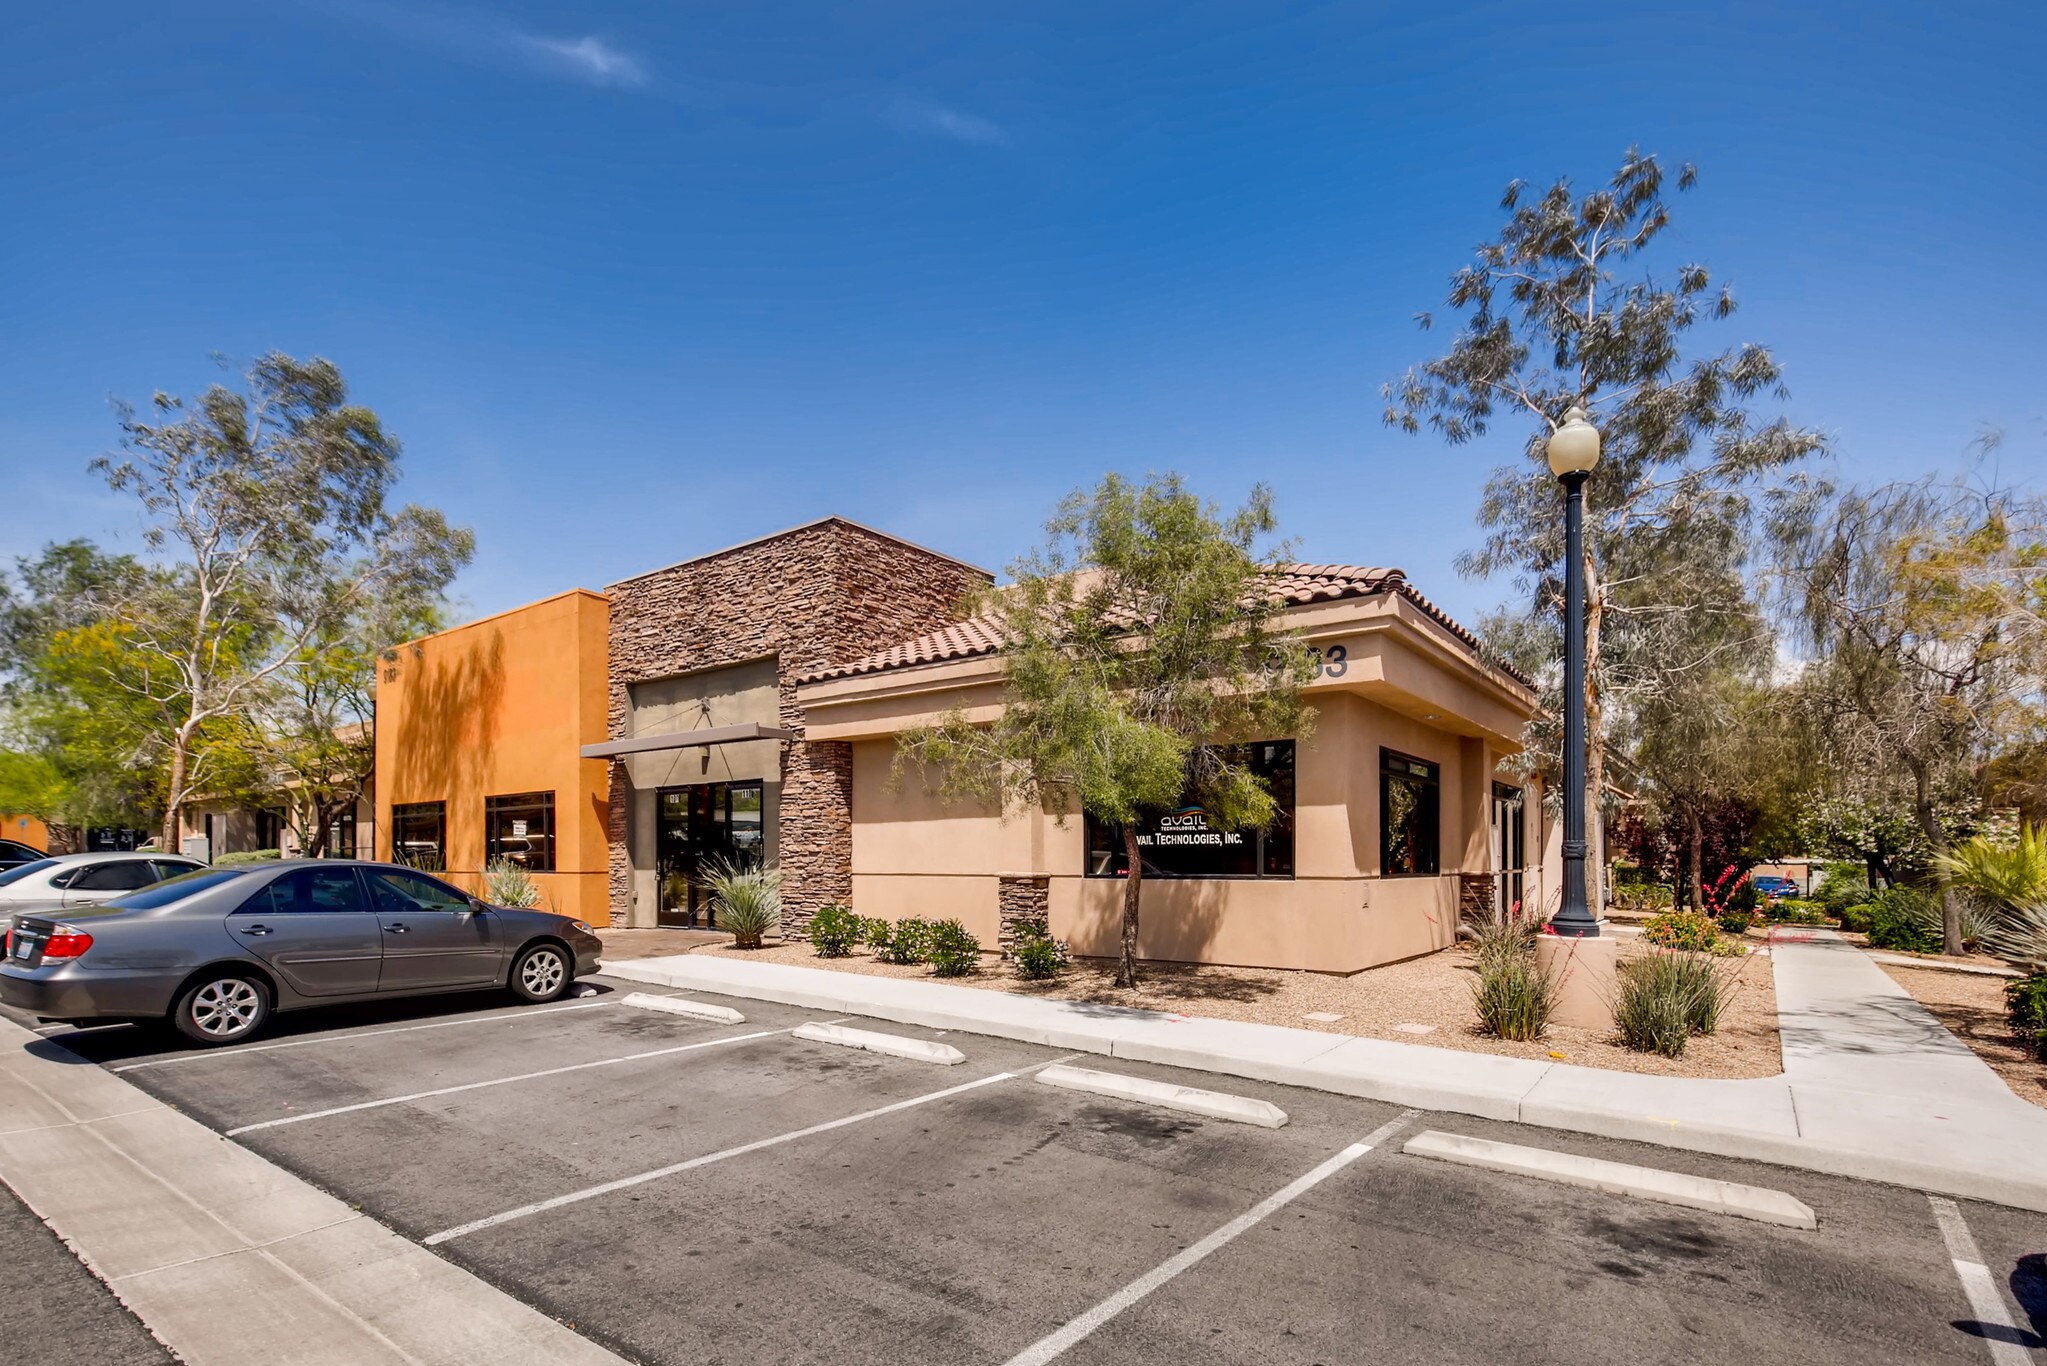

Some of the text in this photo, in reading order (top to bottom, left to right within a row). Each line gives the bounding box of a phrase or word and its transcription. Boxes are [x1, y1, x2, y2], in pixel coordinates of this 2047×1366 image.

[1136, 831, 1243, 847] VAIL TECHNOLOGIES, INC.
